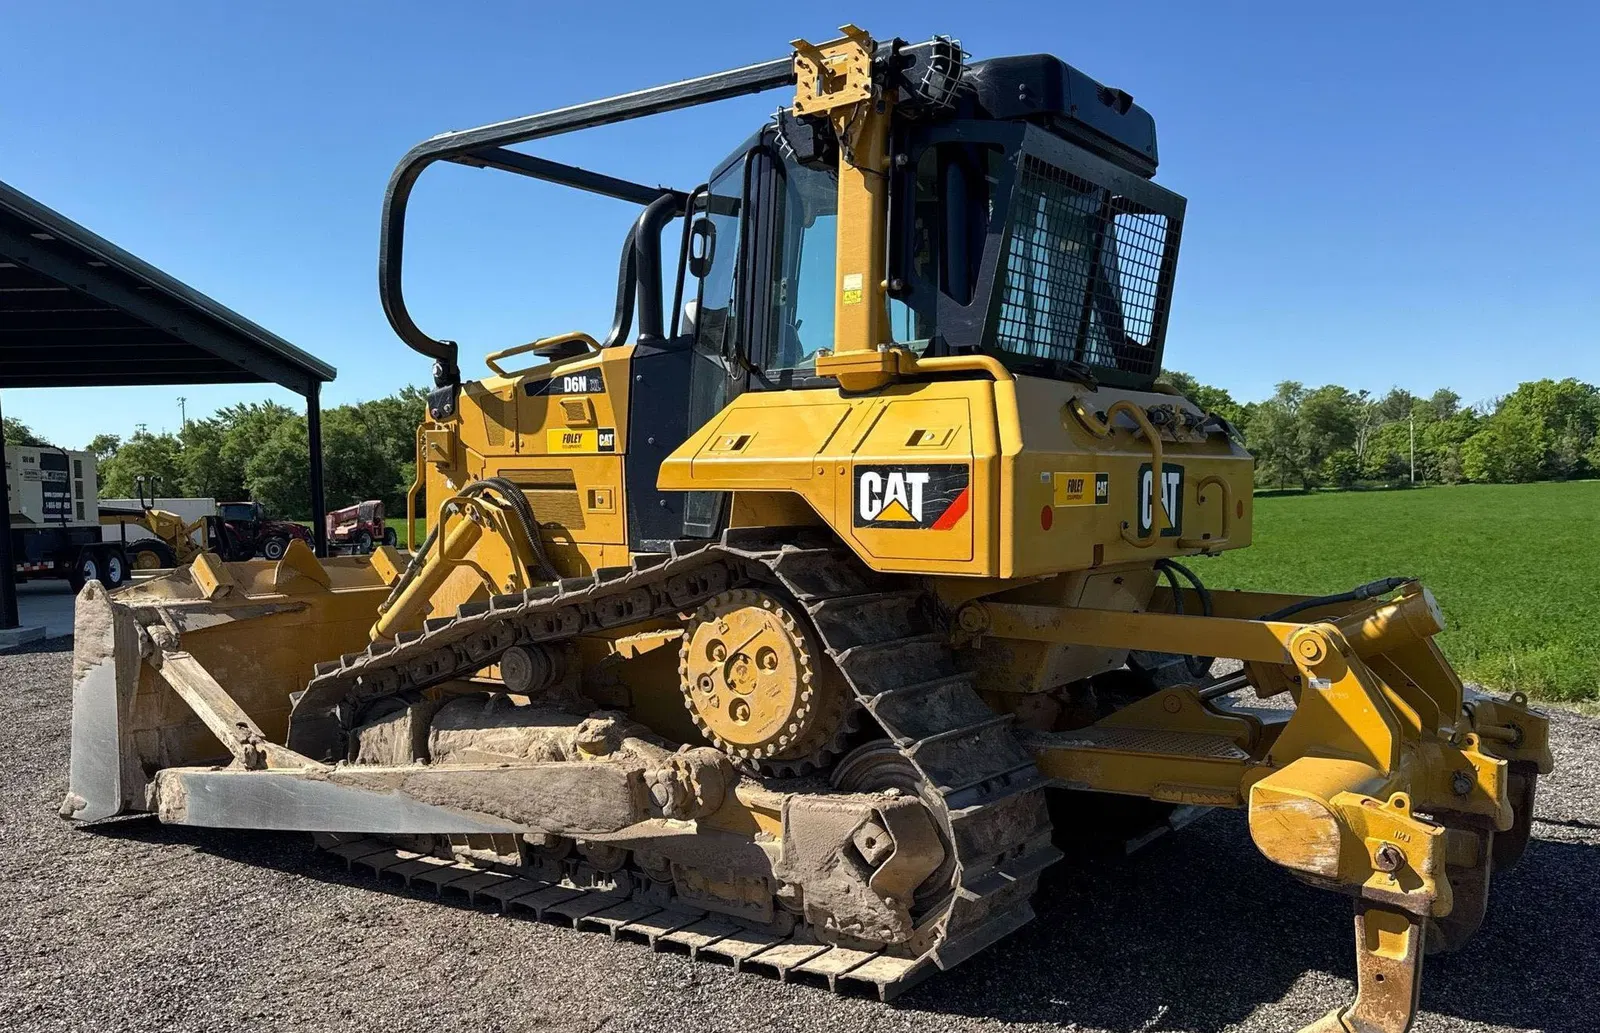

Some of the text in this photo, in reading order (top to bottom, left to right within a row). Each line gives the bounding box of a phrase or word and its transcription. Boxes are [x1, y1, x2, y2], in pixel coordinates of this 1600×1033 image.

[564, 376, 587, 392] D6N
[562, 433, 583, 443] FOLEY
[599, 434, 614, 446] CAT
[1067, 479, 1085, 493] FOLEY
[1097, 481, 1108, 496] CAT
[860, 471, 929, 522] CAT
